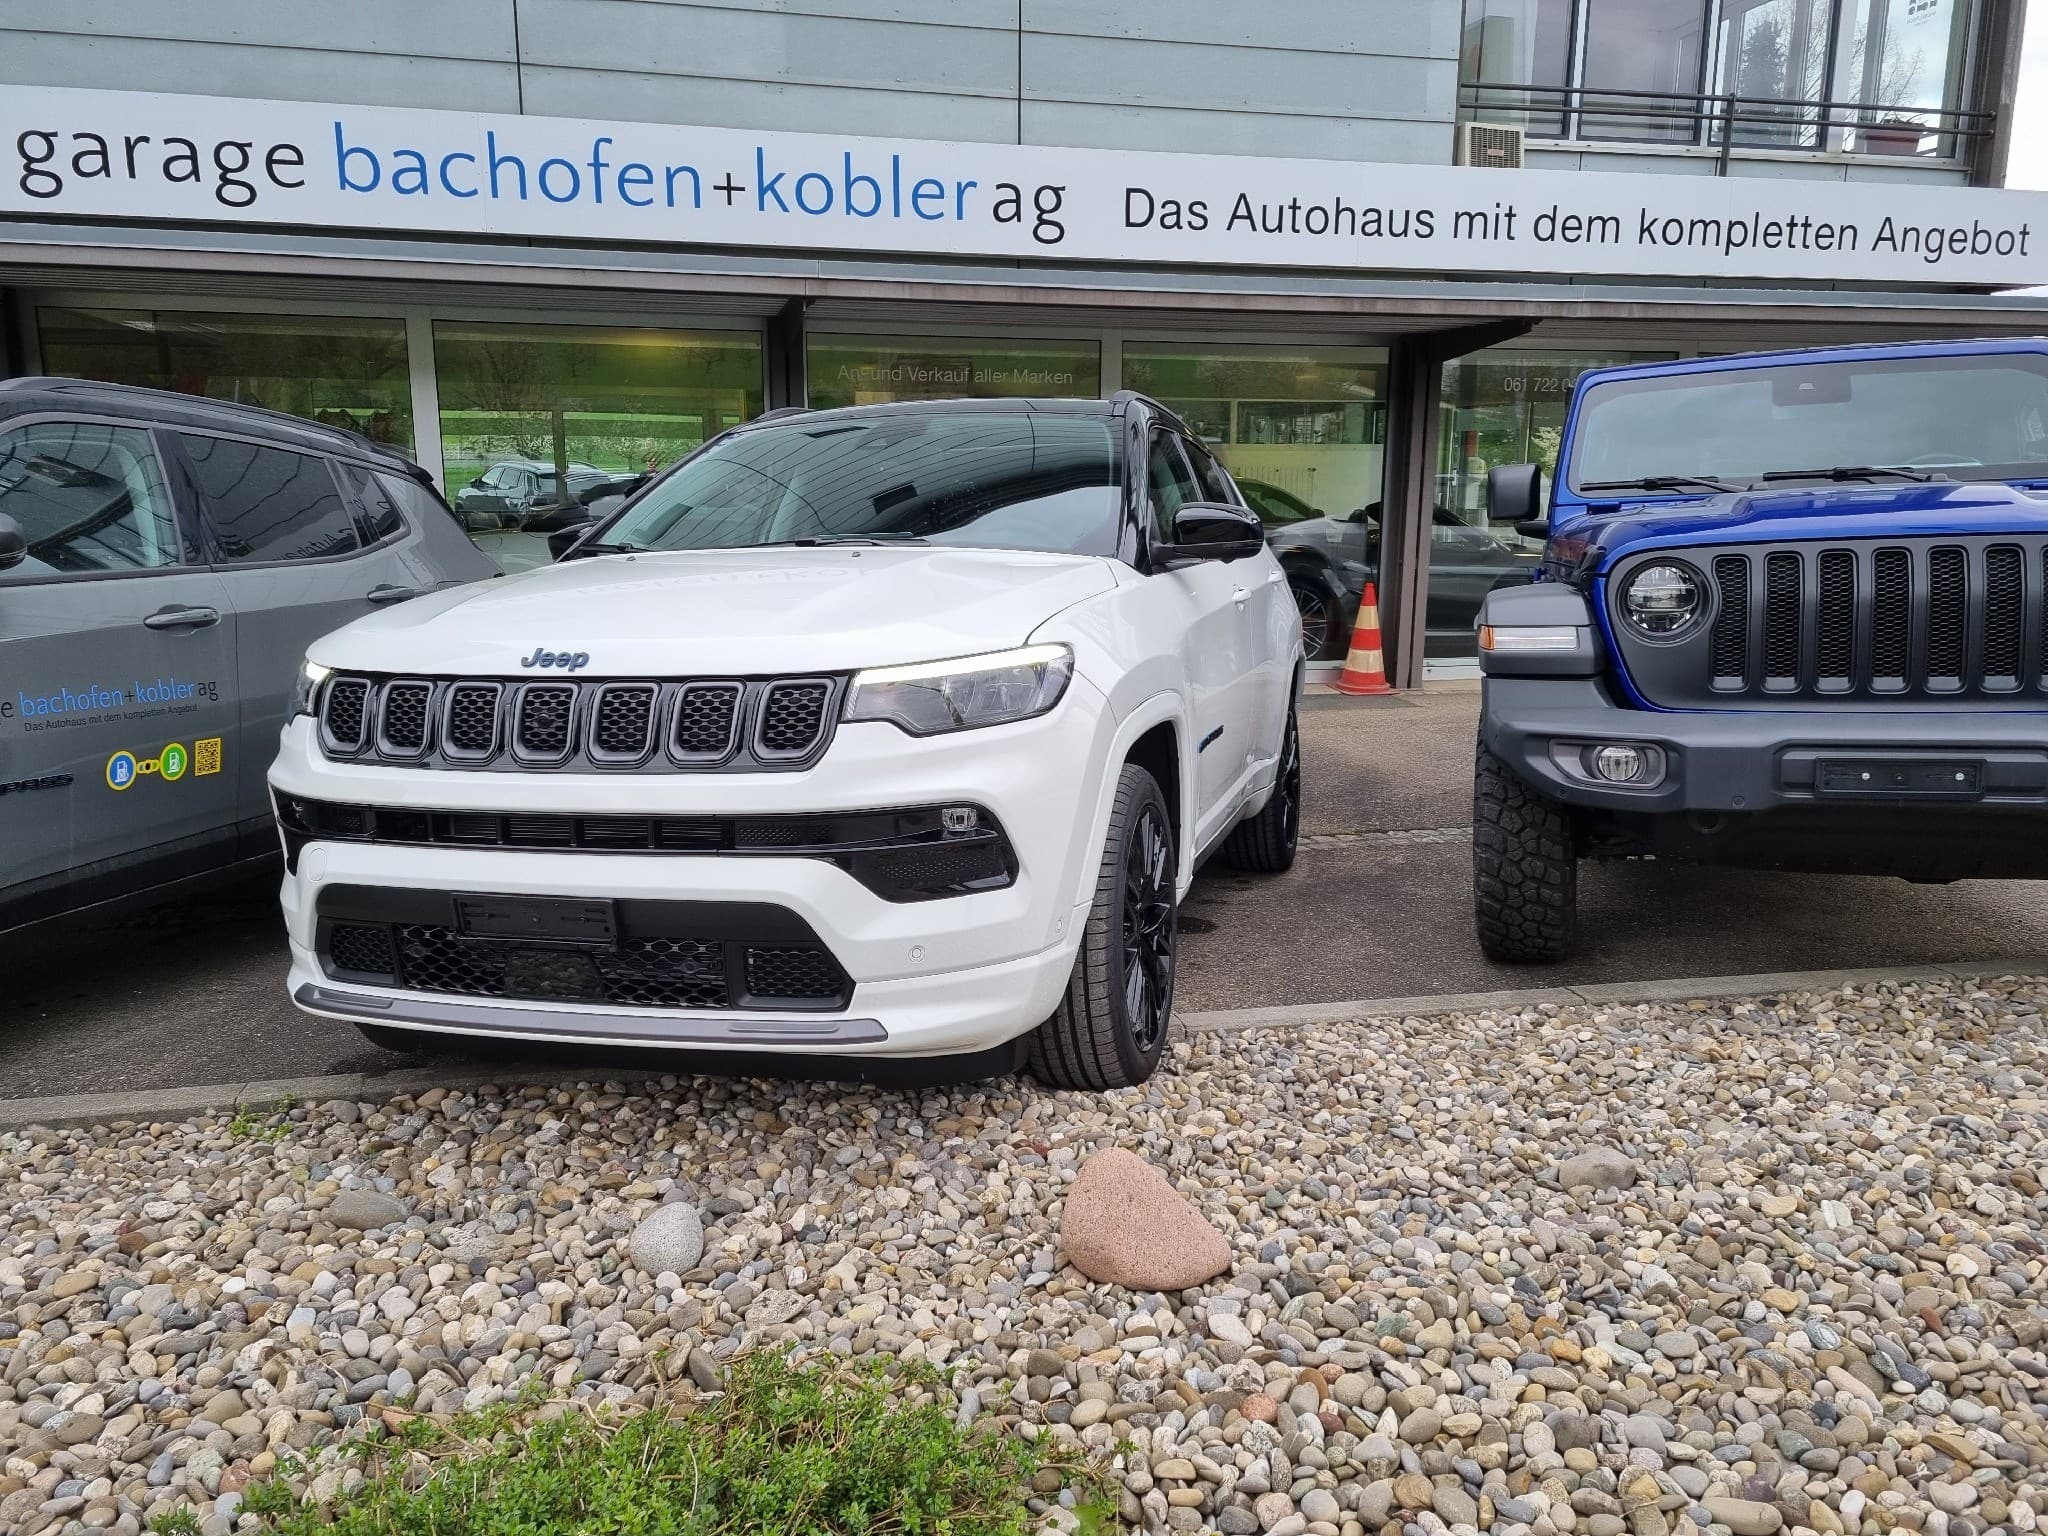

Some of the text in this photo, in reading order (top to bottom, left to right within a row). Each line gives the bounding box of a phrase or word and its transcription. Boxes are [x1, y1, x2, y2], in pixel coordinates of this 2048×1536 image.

[16, 129, 305, 207] garage
[993, 183, 1065, 244] ag
[1125, 188, 2029, 263] Das Autohaus mit dem kompletten Angebot
[871, 366, 902, 381] und
[907, 366, 970, 382] Verkauf
[974, 368, 1008, 383] aller
[1013, 369, 1073, 384] Marken
[1503, 377, 1577, 392] 061 722 0
[520, 647, 590, 672] Jeep
[197, 681, 219, 702] ag
[24, 703, 198, 732] Das Autohaus mit dem kompletten Angebot
